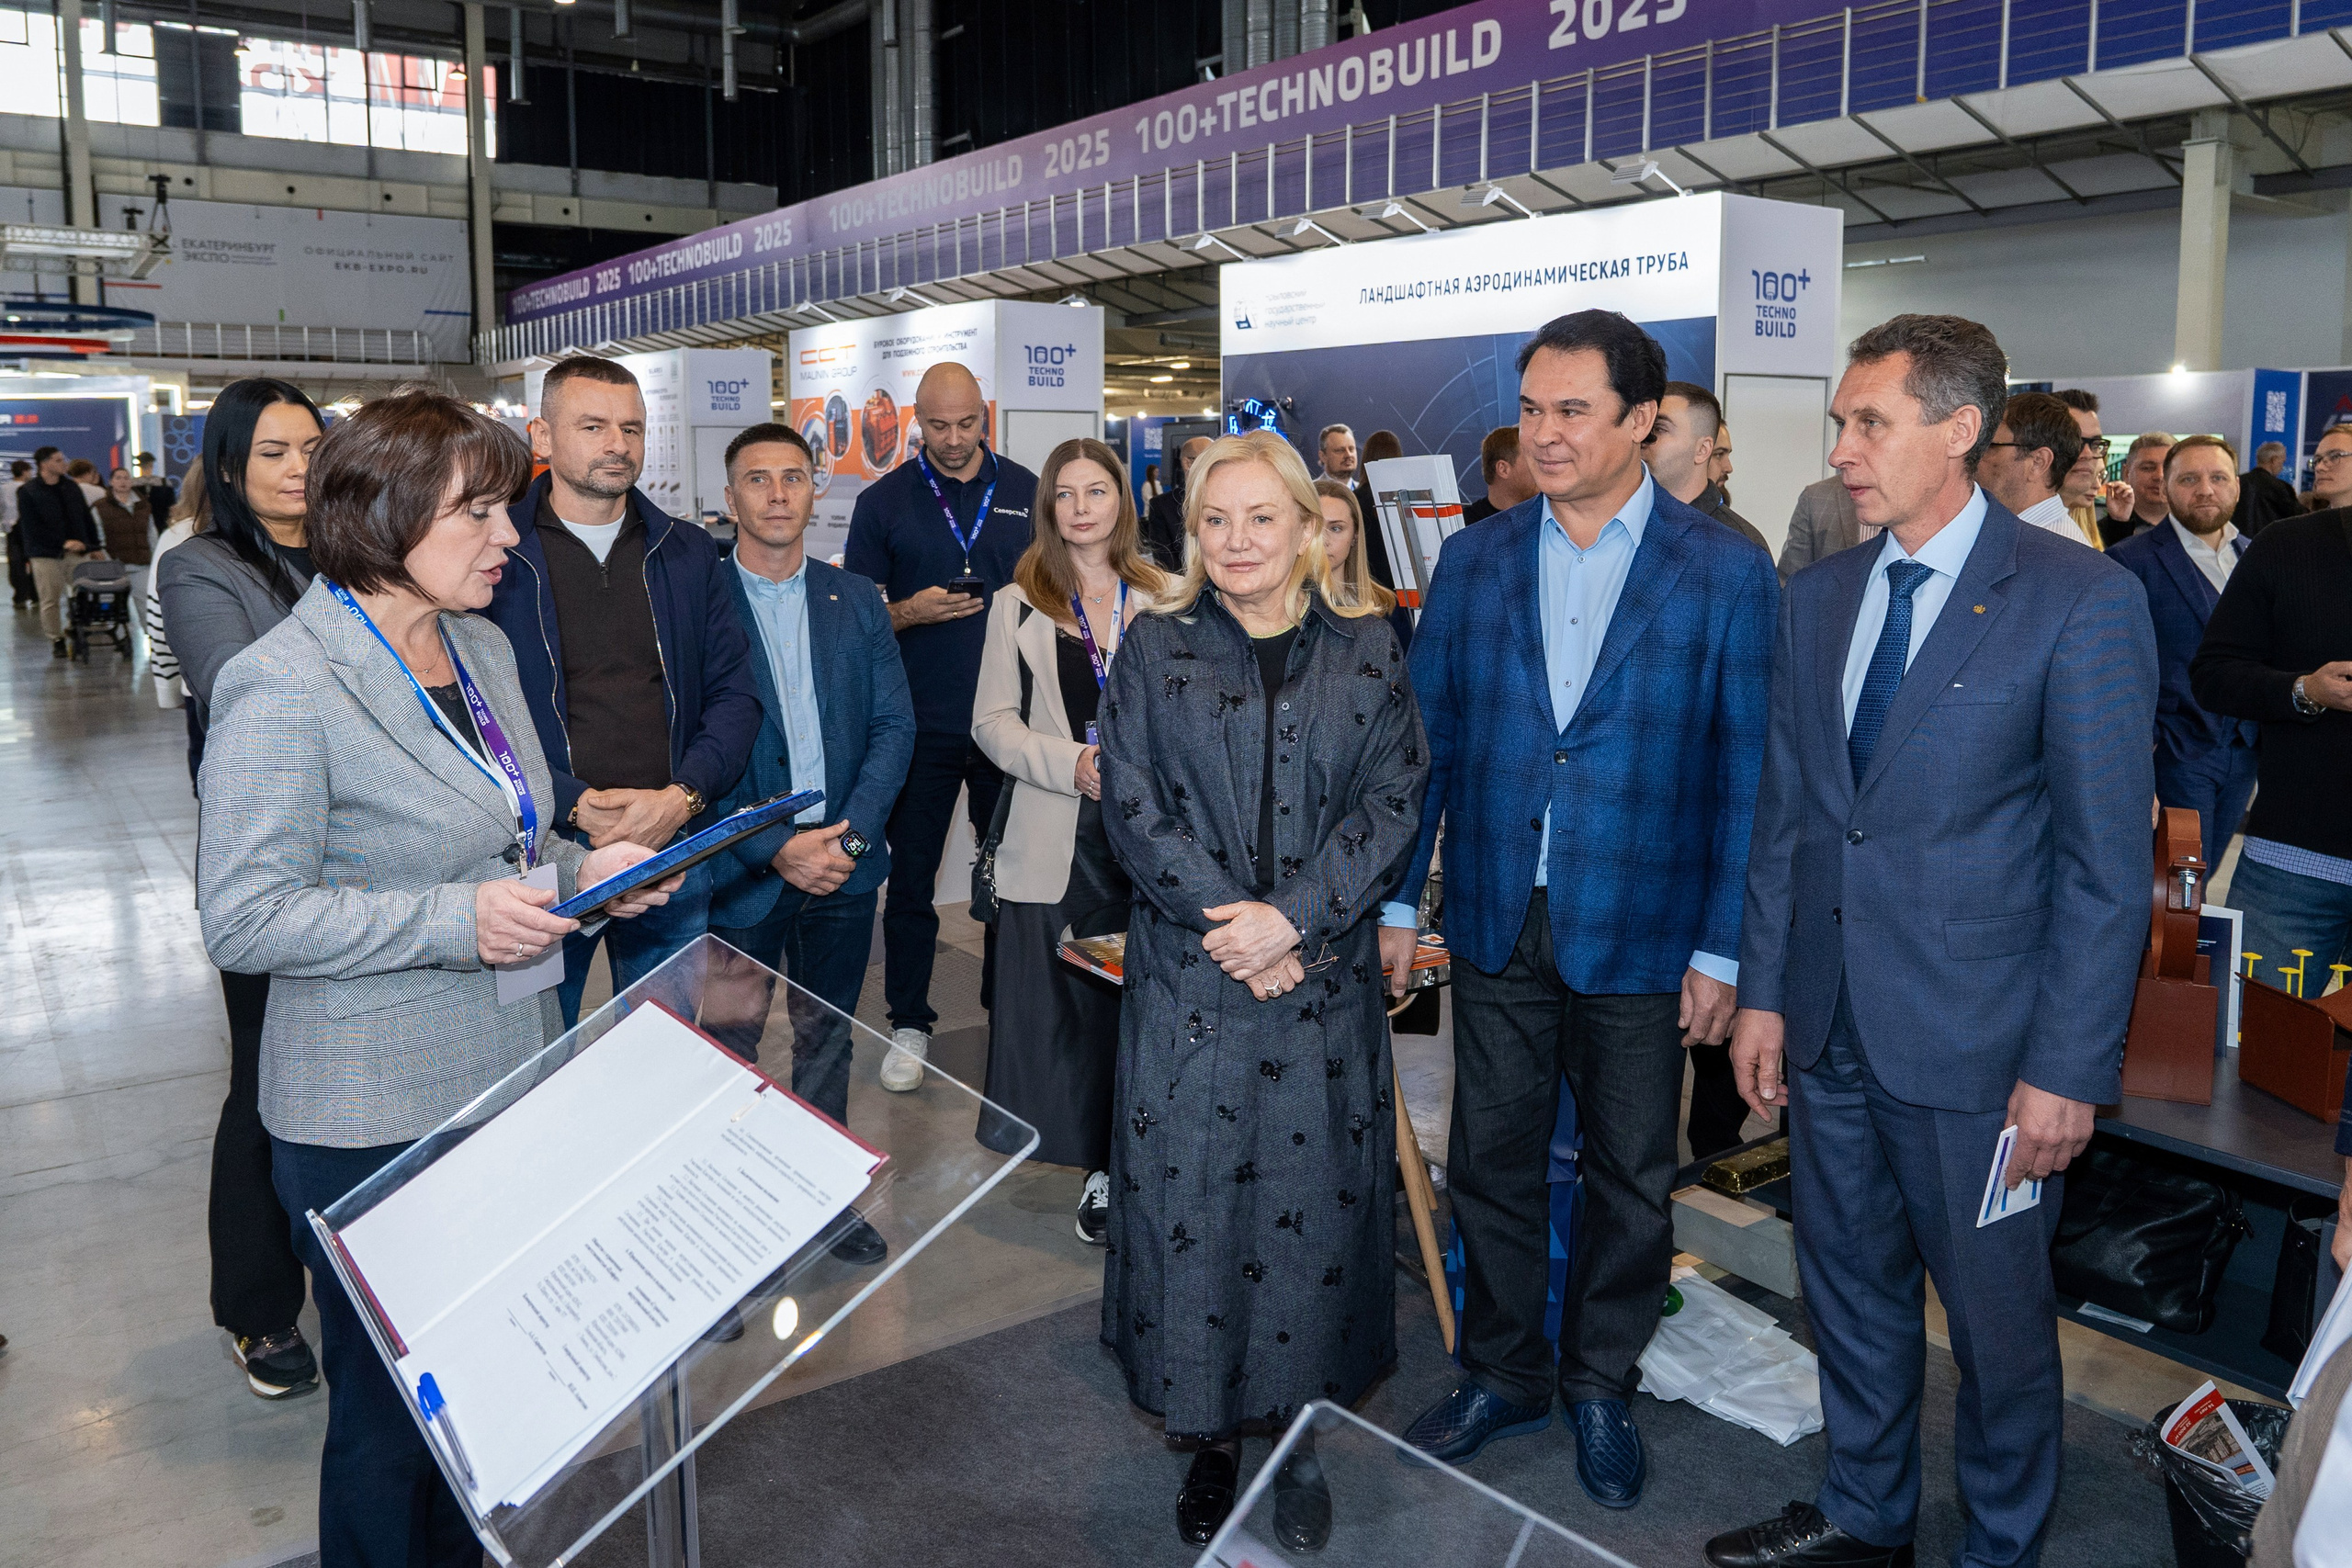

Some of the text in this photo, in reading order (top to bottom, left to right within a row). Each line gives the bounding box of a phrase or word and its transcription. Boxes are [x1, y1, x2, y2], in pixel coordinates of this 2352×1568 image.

[596, 266, 621, 294] 2025
[628, 232, 742, 285] 100+TECHNOBUILD
[754, 220, 793, 253] 2025
[829, 154, 1023, 233] 100+TECHNOBUILD
[1045, 129, 1110, 179] 2025
[1135, 19, 1502, 154] 100+TECHNOBUILD
[182, 238, 276, 254] ЕКАТЕРИНБУРГ
[303, 244, 454, 264] ОФИЦИАЛЬНЫЙ САЙТ
[183, 250, 230, 264] ЭКСПО
[334, 261, 428, 275] EKB-EXPO.RU
[1360, 251, 1689, 305] ЛАНДШАФТНАЯ АЭРОДИНАМИЧЕСКАЯ ТРУБА
[1752, 267, 1811, 303] 100+
[1756, 304, 1796, 320] TECHNO
[1755, 319, 1796, 338] BUILD
[1024, 343, 1077, 365] 100+
[831, 366, 857, 378] GROUP
[1029, 367, 1065, 376] TECHNO
[707, 378, 750, 394] 100+
[1028, 376, 1065, 387] BUILD
[711, 402, 741, 411] BUILD
[466, 682, 482, 707] 100+
[476, 710, 486, 727] BUILD
[499, 750, 520, 777] 100+
